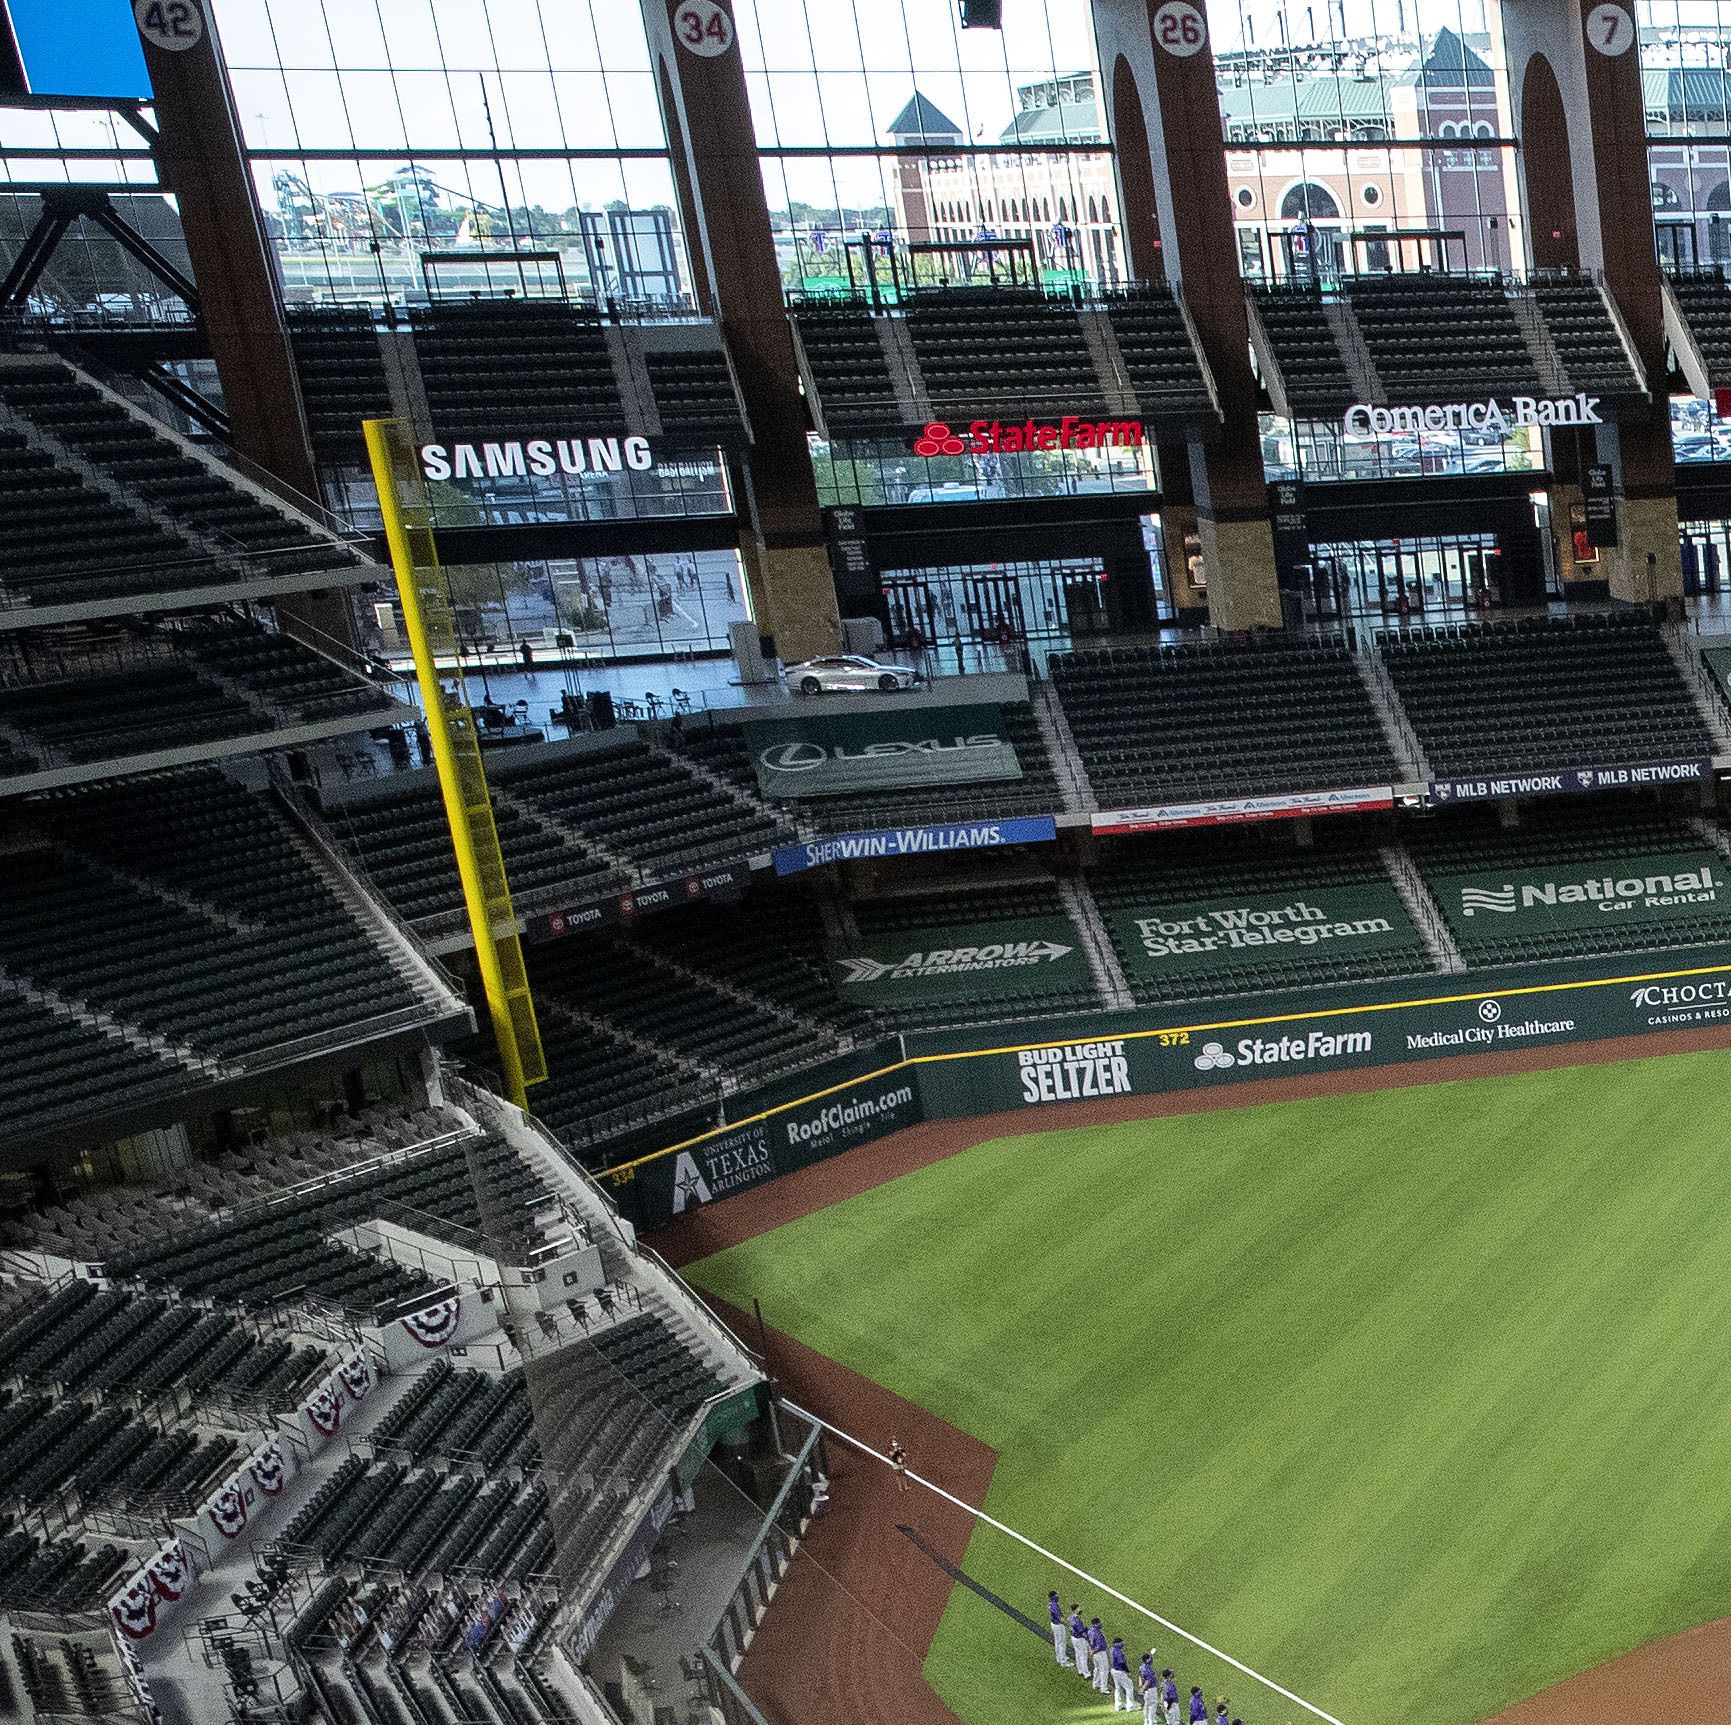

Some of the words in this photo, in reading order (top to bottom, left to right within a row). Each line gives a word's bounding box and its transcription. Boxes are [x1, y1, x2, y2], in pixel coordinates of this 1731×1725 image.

[145, 1, 194, 38] 42
[682, 12, 728, 45] 34
[1160, 13, 1200, 45] 26
[1602, 15, 1620, 46] 7
[1511, 393, 1602, 427] Bank
[423, 437, 652, 480] SAMSUNG
[835, 733, 999, 761] LEXUS
[1456, 780, 1488, 798] MLB
[1490, 775, 1562, 796] NETWORK
[1598, 768, 1629, 785] MLB
[1631, 763, 1700, 783] NETWORK
[702, 874, 734, 889] TOYOTA
[637, 890, 670, 907] TOYOTA
[1598, 897, 1641, 913] Car
[1645, 889, 1716, 909] Rental
[567, 908, 602, 926] TOYOTA
[1135, 910, 1208, 941] Fort
[1210, 901, 1327, 936] Worth
[1143, 913, 1394, 957] Star-Telegram
[891, 955, 1040, 980] EXTERMINATORS
[896, 940, 1045, 968] ARROW
[1407, 1028, 1463, 1050] Medical
[1466, 1025, 1495, 1048] City
[1496, 1018, 1575, 1041] Healthcare
[1647, 1012, 1693, 1025] CASINOS
[1018, 1048, 1063, 1067] BUD
[1064, 1040, 1125, 1062] LIGHT
[1159, 1032, 1191, 1047] 372
[1020, 1056, 1131, 1101] SELTZER
[787, 1086, 912, 1145] RoofClaim.com
[704, 1132, 752, 1157] UNIVERSITY
[752, 1126, 765, 1139] OF
[706, 1139, 770, 1181] TEXAS
[711, 1162, 773, 1194] ARLINGTON
